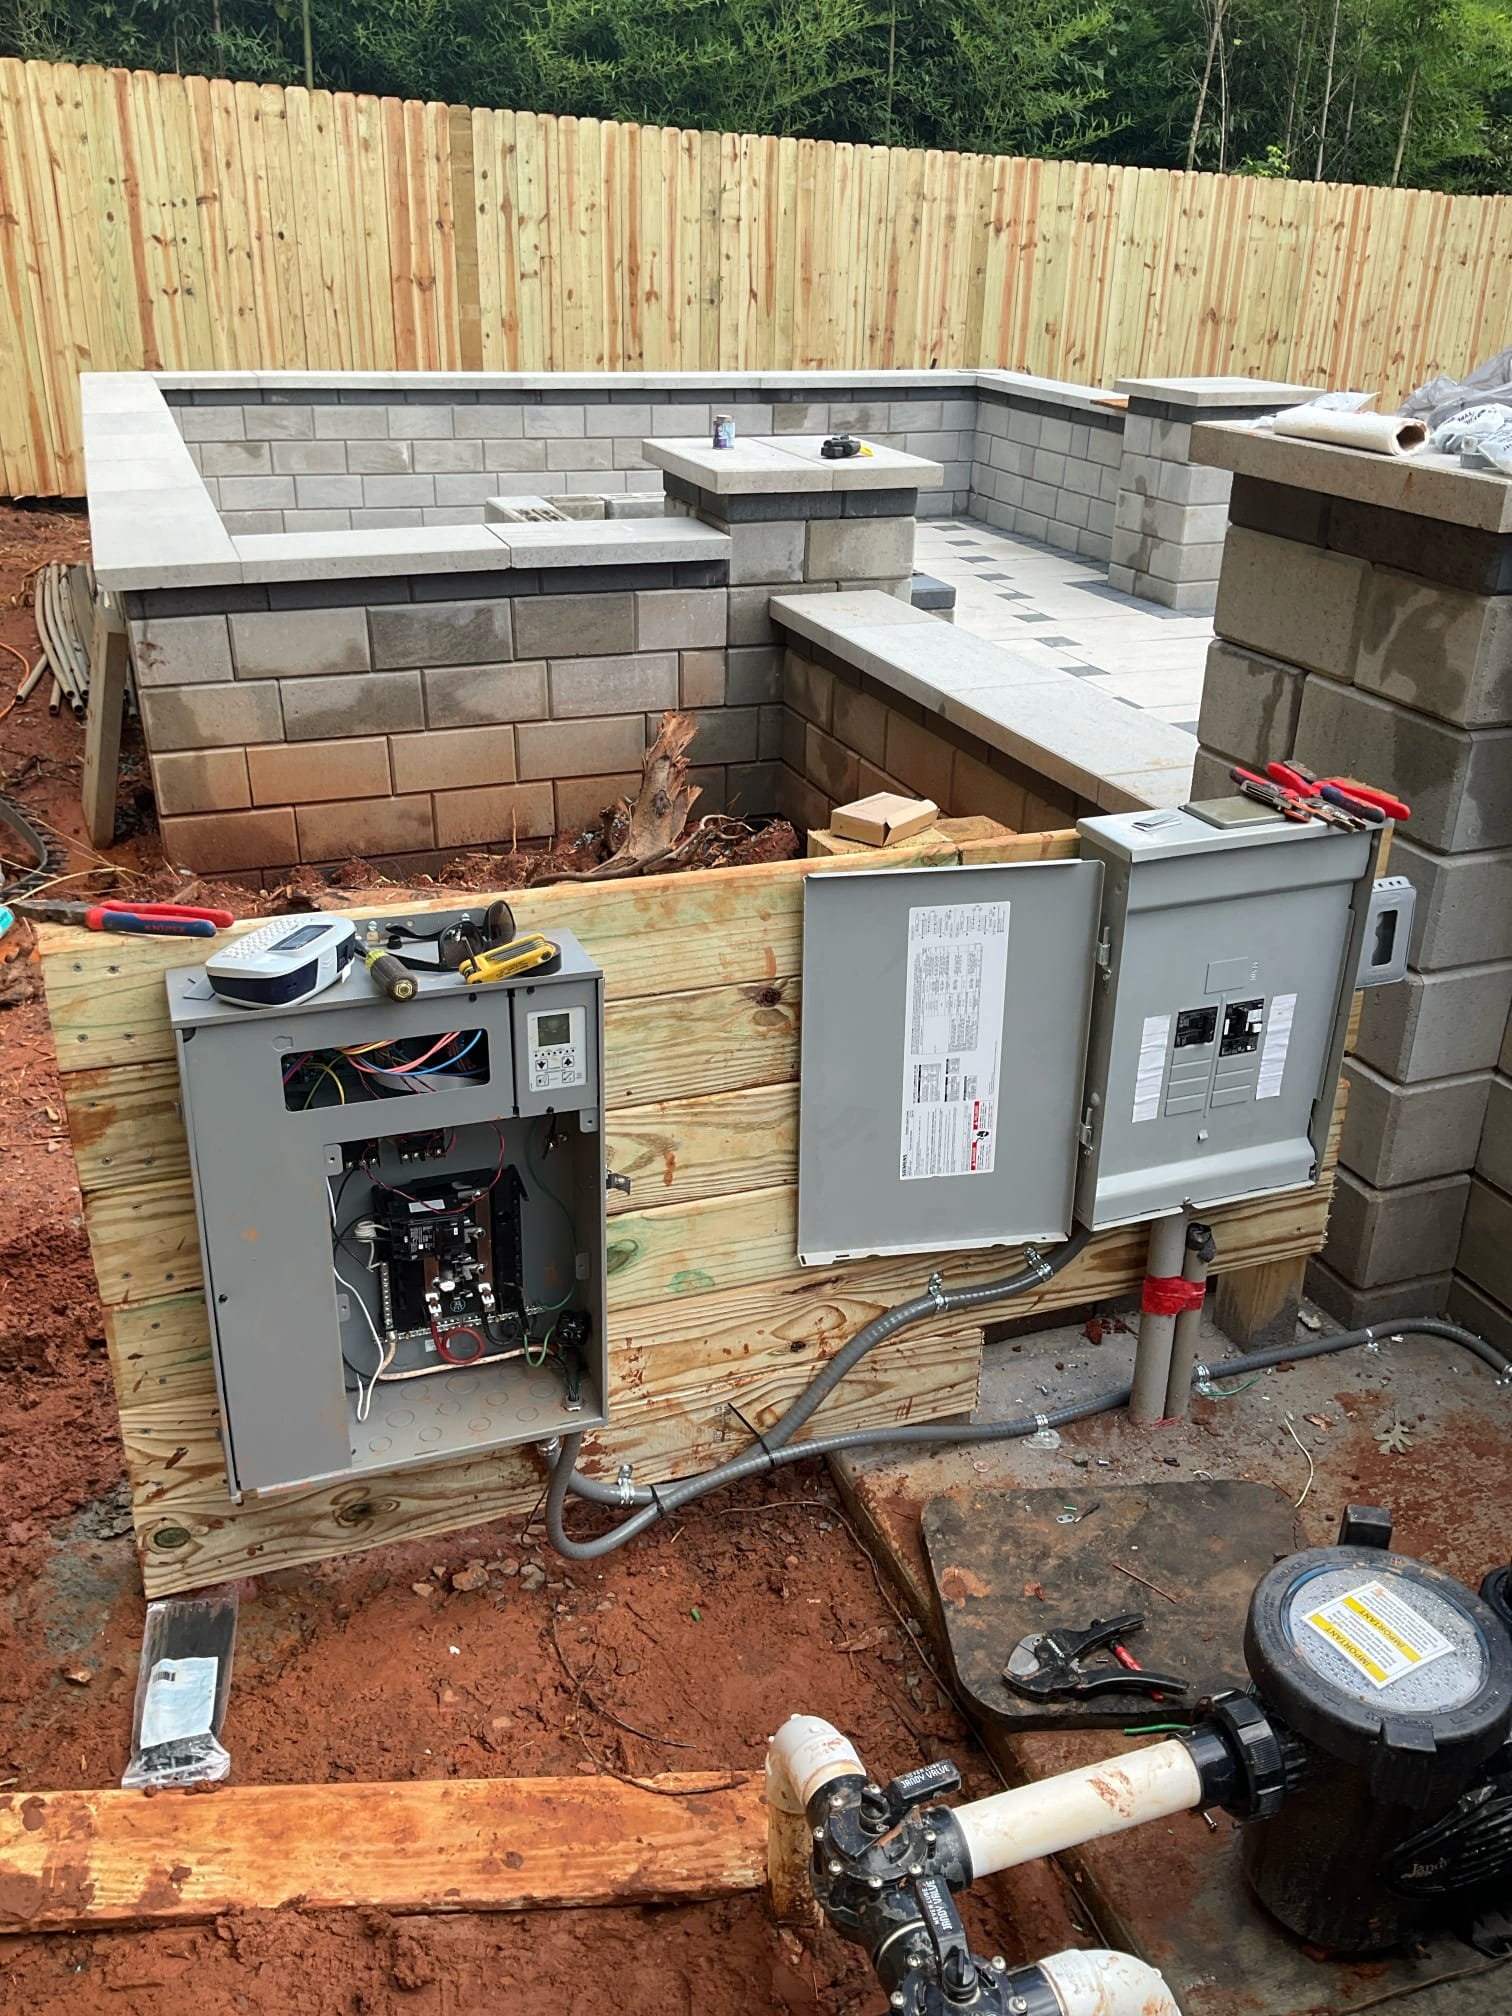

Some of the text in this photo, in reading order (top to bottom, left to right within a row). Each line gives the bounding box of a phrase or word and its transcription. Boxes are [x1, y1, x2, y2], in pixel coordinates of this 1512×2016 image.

[1324, 1627, 1370, 1667] IMPORTANT
[1358, 1609, 1405, 1649] IMPORTANT
[901, 1764, 950, 1789] JANDY VALVE
[925, 1880, 952, 1930] JANDY VALVE
[928, 1904, 940, 1925] NEVER
